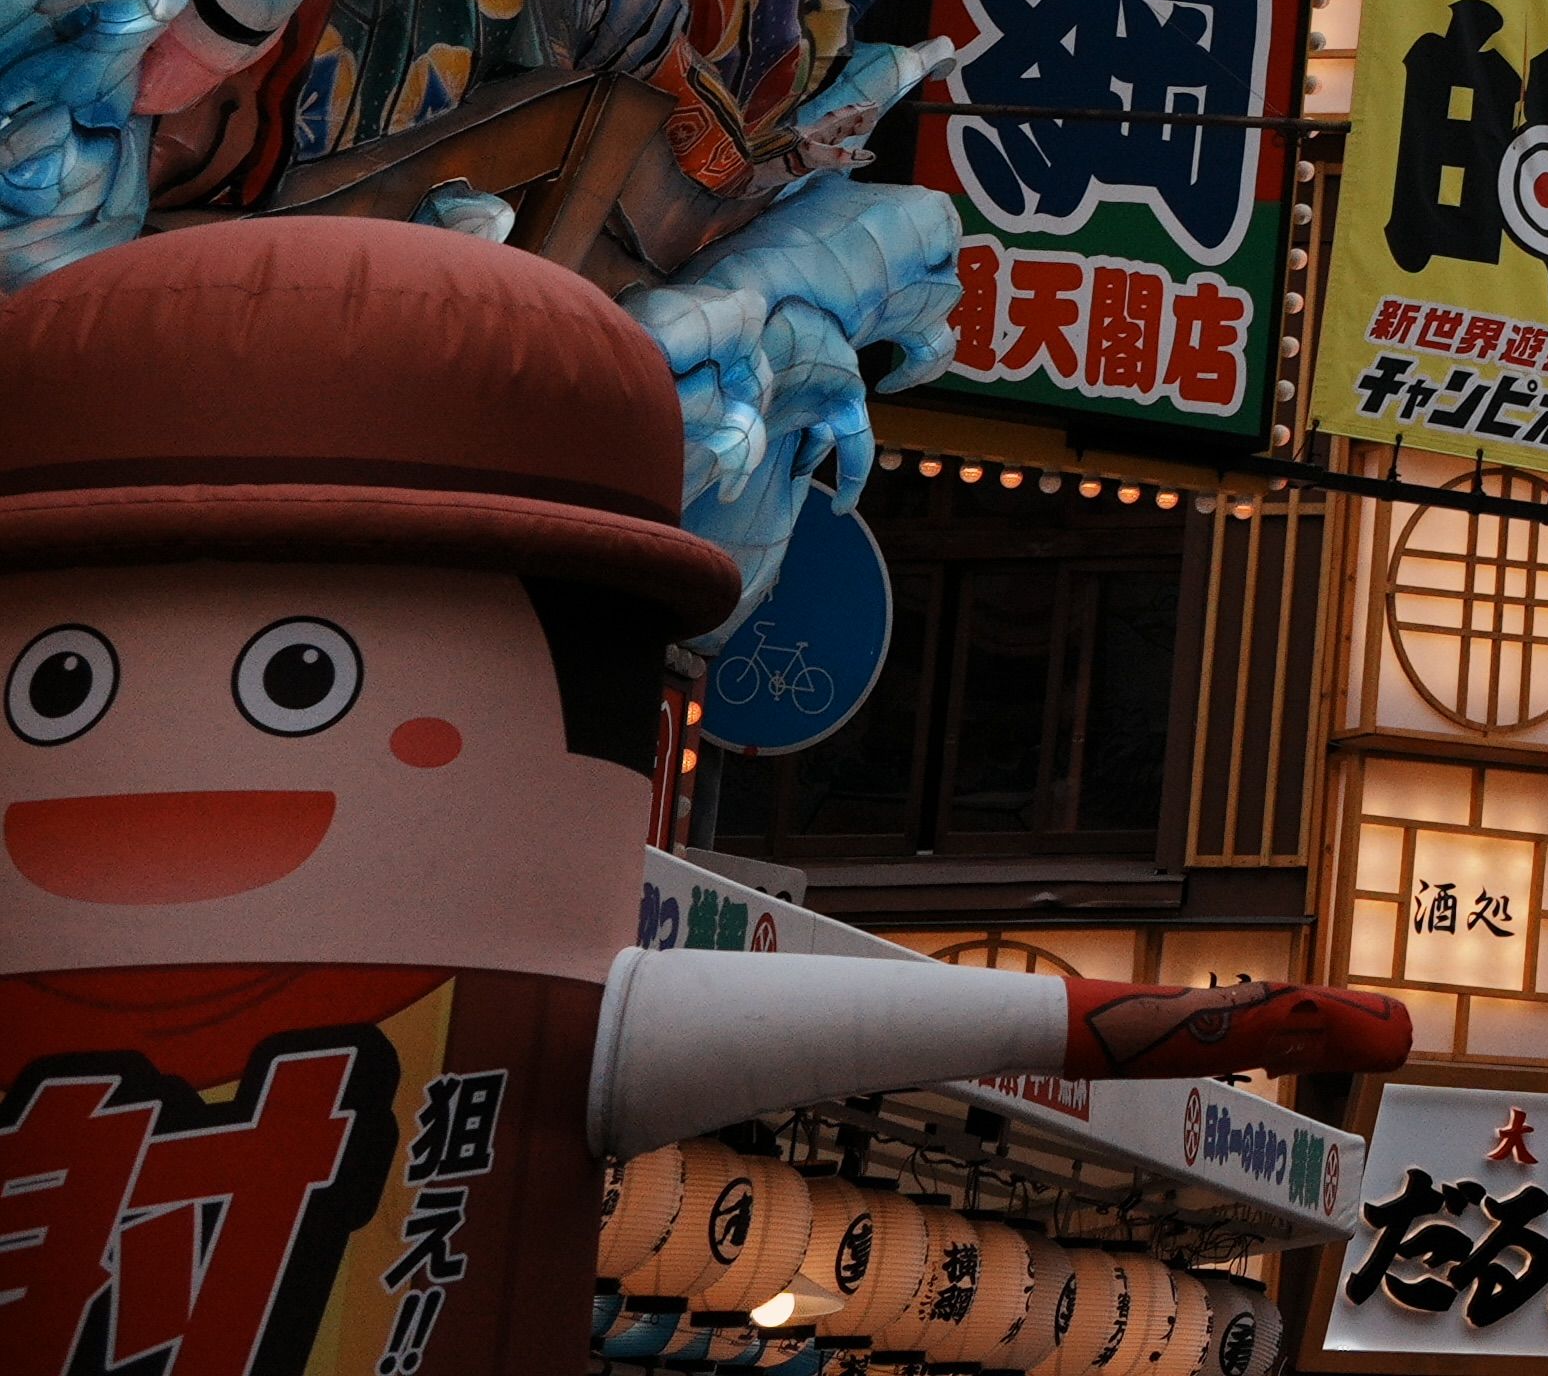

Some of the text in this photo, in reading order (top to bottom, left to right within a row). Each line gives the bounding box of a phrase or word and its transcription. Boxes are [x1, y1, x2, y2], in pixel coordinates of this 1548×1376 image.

[948, 246, 1246, 411] 通天閣店
[1413, 880, 1514, 938] 酒処
